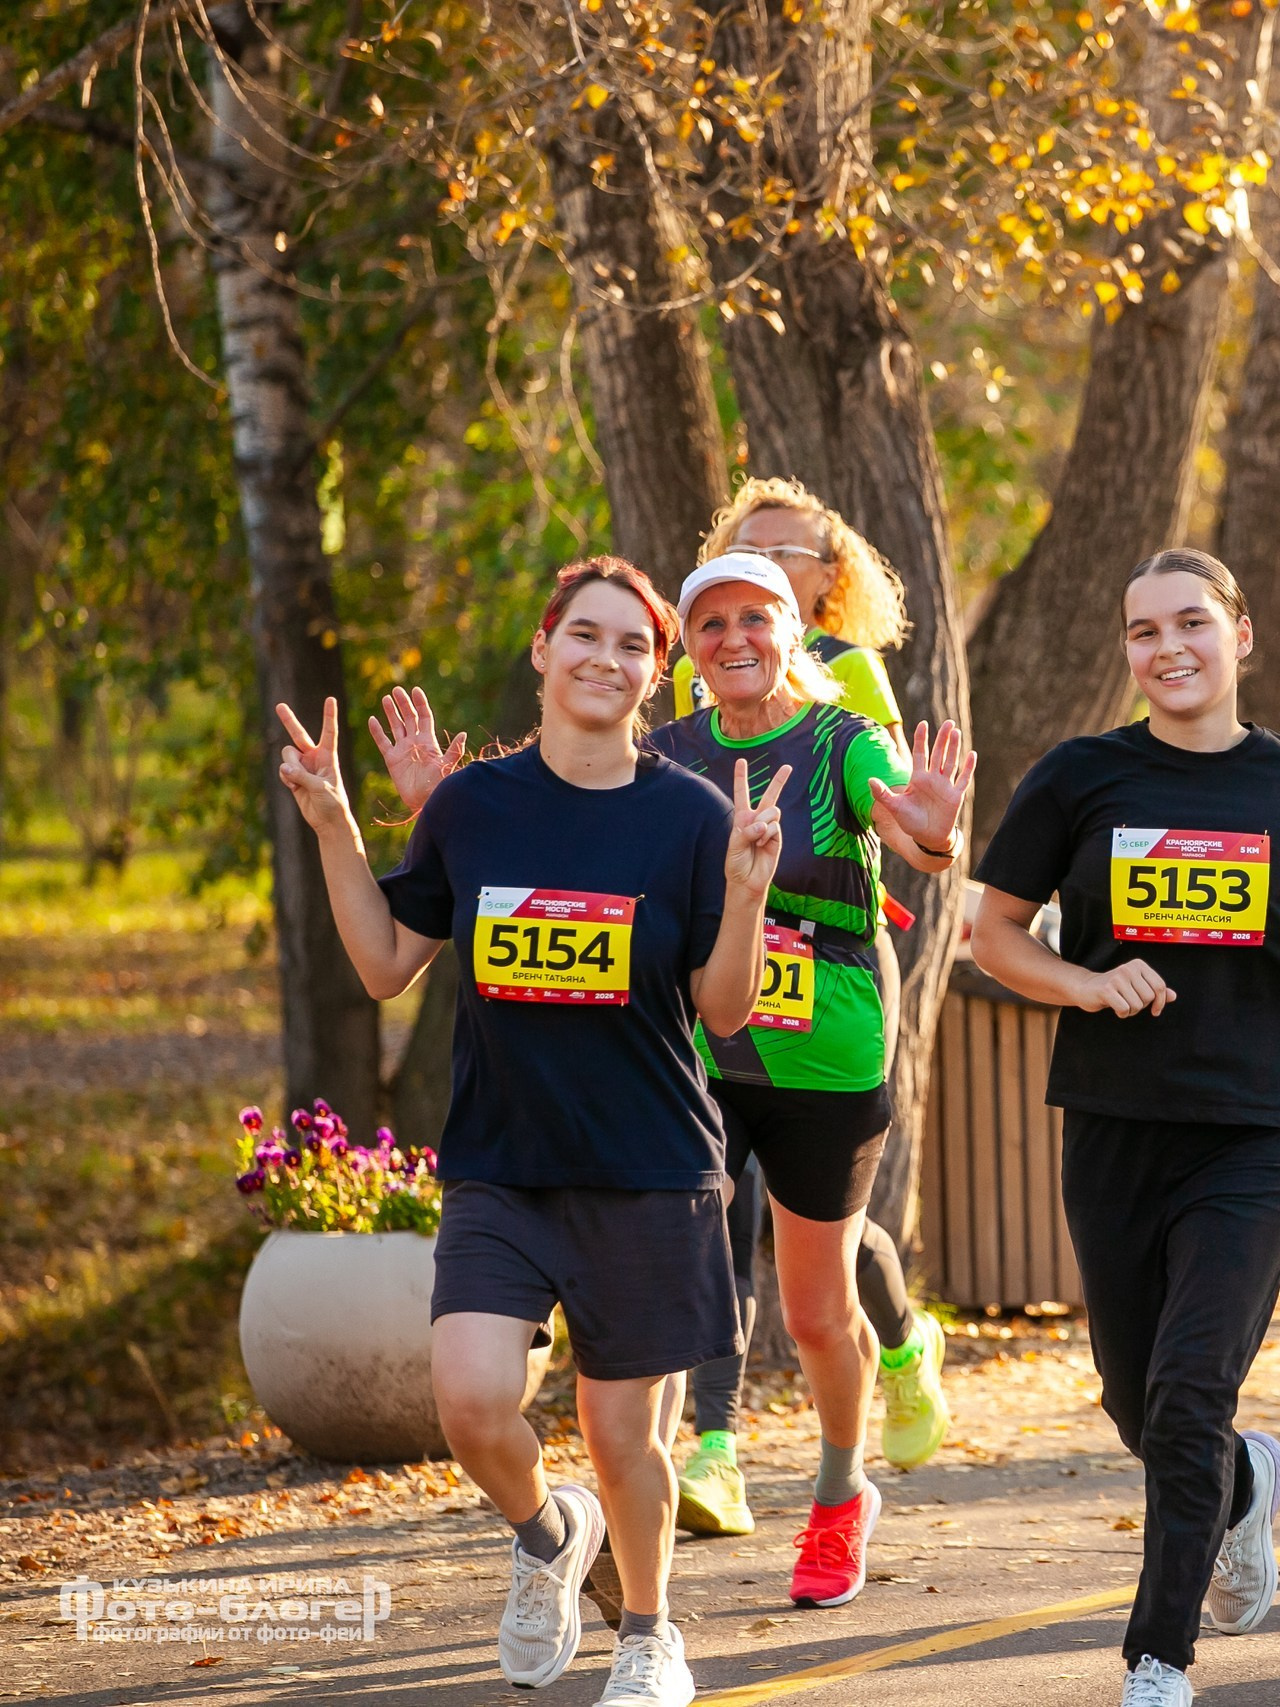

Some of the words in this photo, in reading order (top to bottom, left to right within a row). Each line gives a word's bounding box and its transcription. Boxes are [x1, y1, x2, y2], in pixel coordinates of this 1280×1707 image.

[1129, 840, 1150, 849] СБЕР
[1166, 838, 1222, 848] КРАСНОЯРСКИЕ
[1181, 845, 1207, 853] МОСТЫ
[1240, 846, 1246, 854] 5
[1126, 865, 1252, 912] 5153
[603, 907, 609, 915] 5
[1143, 912, 1174, 921] БРЕНЧ
[1175, 914, 1232, 923] АНАСТАСИЯ
[1232, 932, 1251, 940] 2026
[487, 923, 615, 973] 5154
[512, 972, 543, 981] БРЕНЧ
[544, 974, 586, 984] ТАТЬЯНА
[761, 957, 804, 1001] 01
[756, 1000, 781, 1009] РИНА
